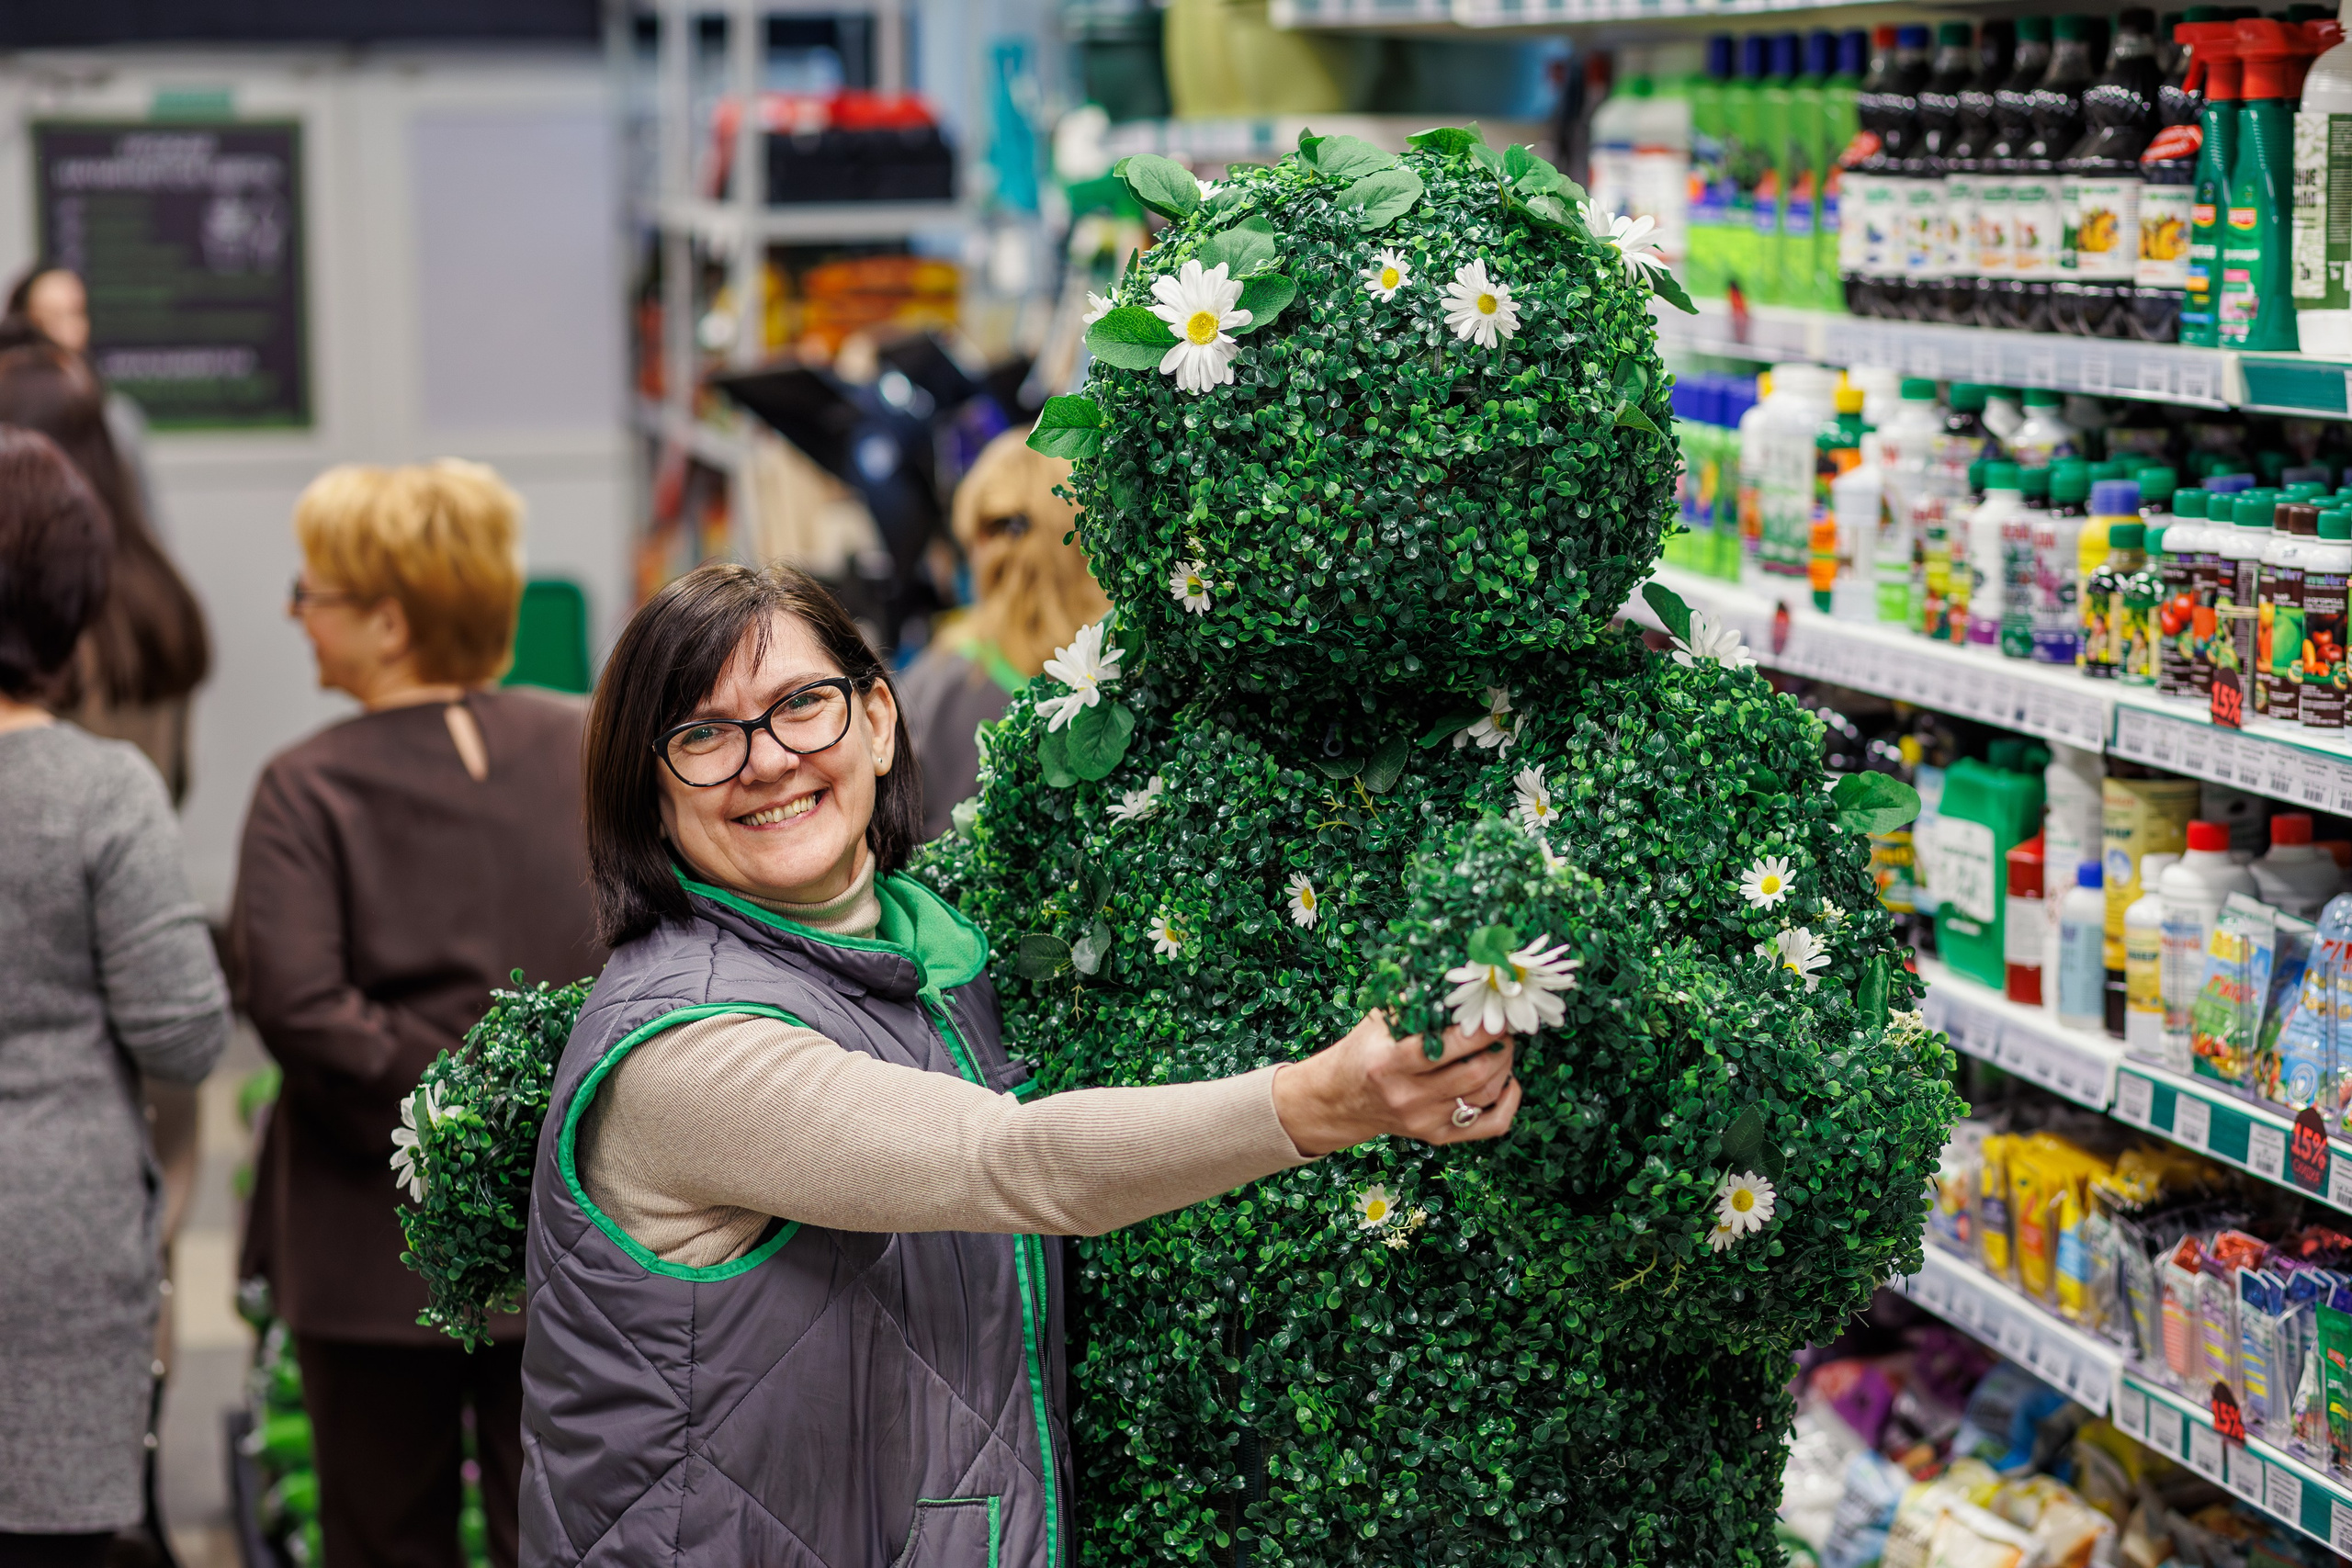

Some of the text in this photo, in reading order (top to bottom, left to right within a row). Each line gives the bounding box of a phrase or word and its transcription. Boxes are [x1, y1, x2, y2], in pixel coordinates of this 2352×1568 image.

[2211, 681, 2243, 724] 15%
[2291, 1122, 2327, 1170] 15%
[2212, 1398, 2245, 1439] 15%
